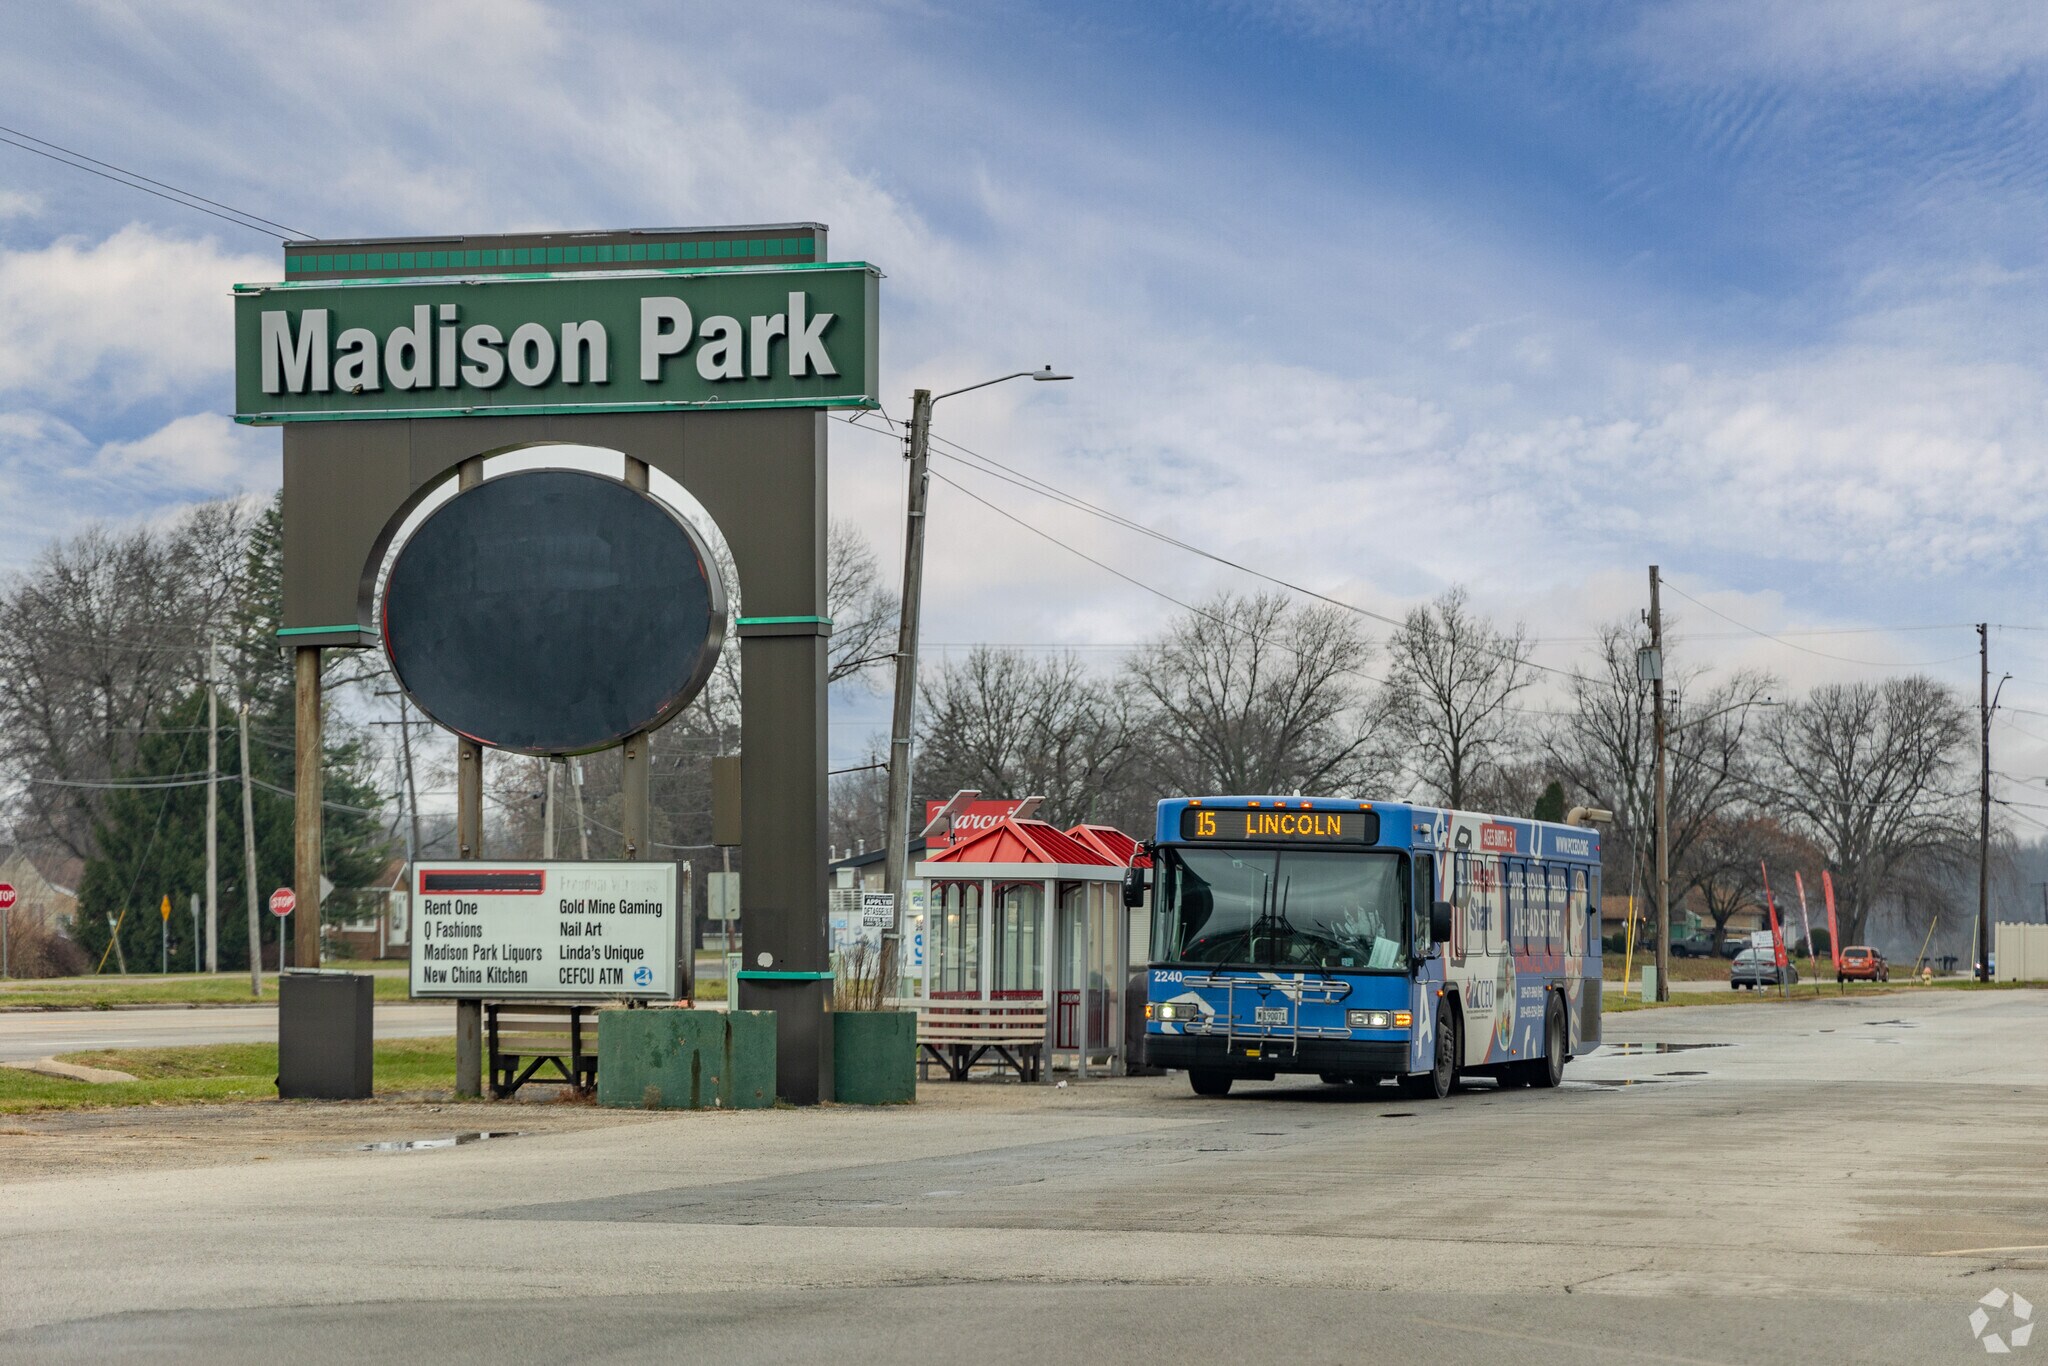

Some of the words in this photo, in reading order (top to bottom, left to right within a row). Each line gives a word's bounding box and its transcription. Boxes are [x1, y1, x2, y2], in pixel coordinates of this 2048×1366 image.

[260, 304, 610, 394] Madison
[639, 291, 840, 382] Park
[1197, 812, 1216, 836] 15
[1246, 814, 1341, 835] LINCOLN
[0, 890, 14, 902] TOP
[270, 895, 295, 909] STOP
[424, 899, 452, 915] Rent
[455, 899, 478, 915] One
[560, 899, 584, 914] Gold
[588, 899, 616, 914] Mine
[619, 899, 663, 918] Gaming
[1470, 897, 1493, 931] Start
[424, 920, 432, 940] Q
[436, 921, 483, 938] Fashions
[560, 922, 581, 937] Nail
[585, 922, 602, 937] Art
[424, 944, 469, 961] Madison
[473, 944, 498, 961] Park
[502, 944, 543, 963] Liquors
[560, 945, 601, 961] Linda's
[604, 945, 644, 963] Unique
[423, 966, 447, 983] New
[451, 966, 482, 983] China
[486, 966, 528, 983] Kitchen
[559, 967, 594, 984] CEFCU
[599, 967, 623, 985] ATM
[1154, 970, 1183, 983] 2240
